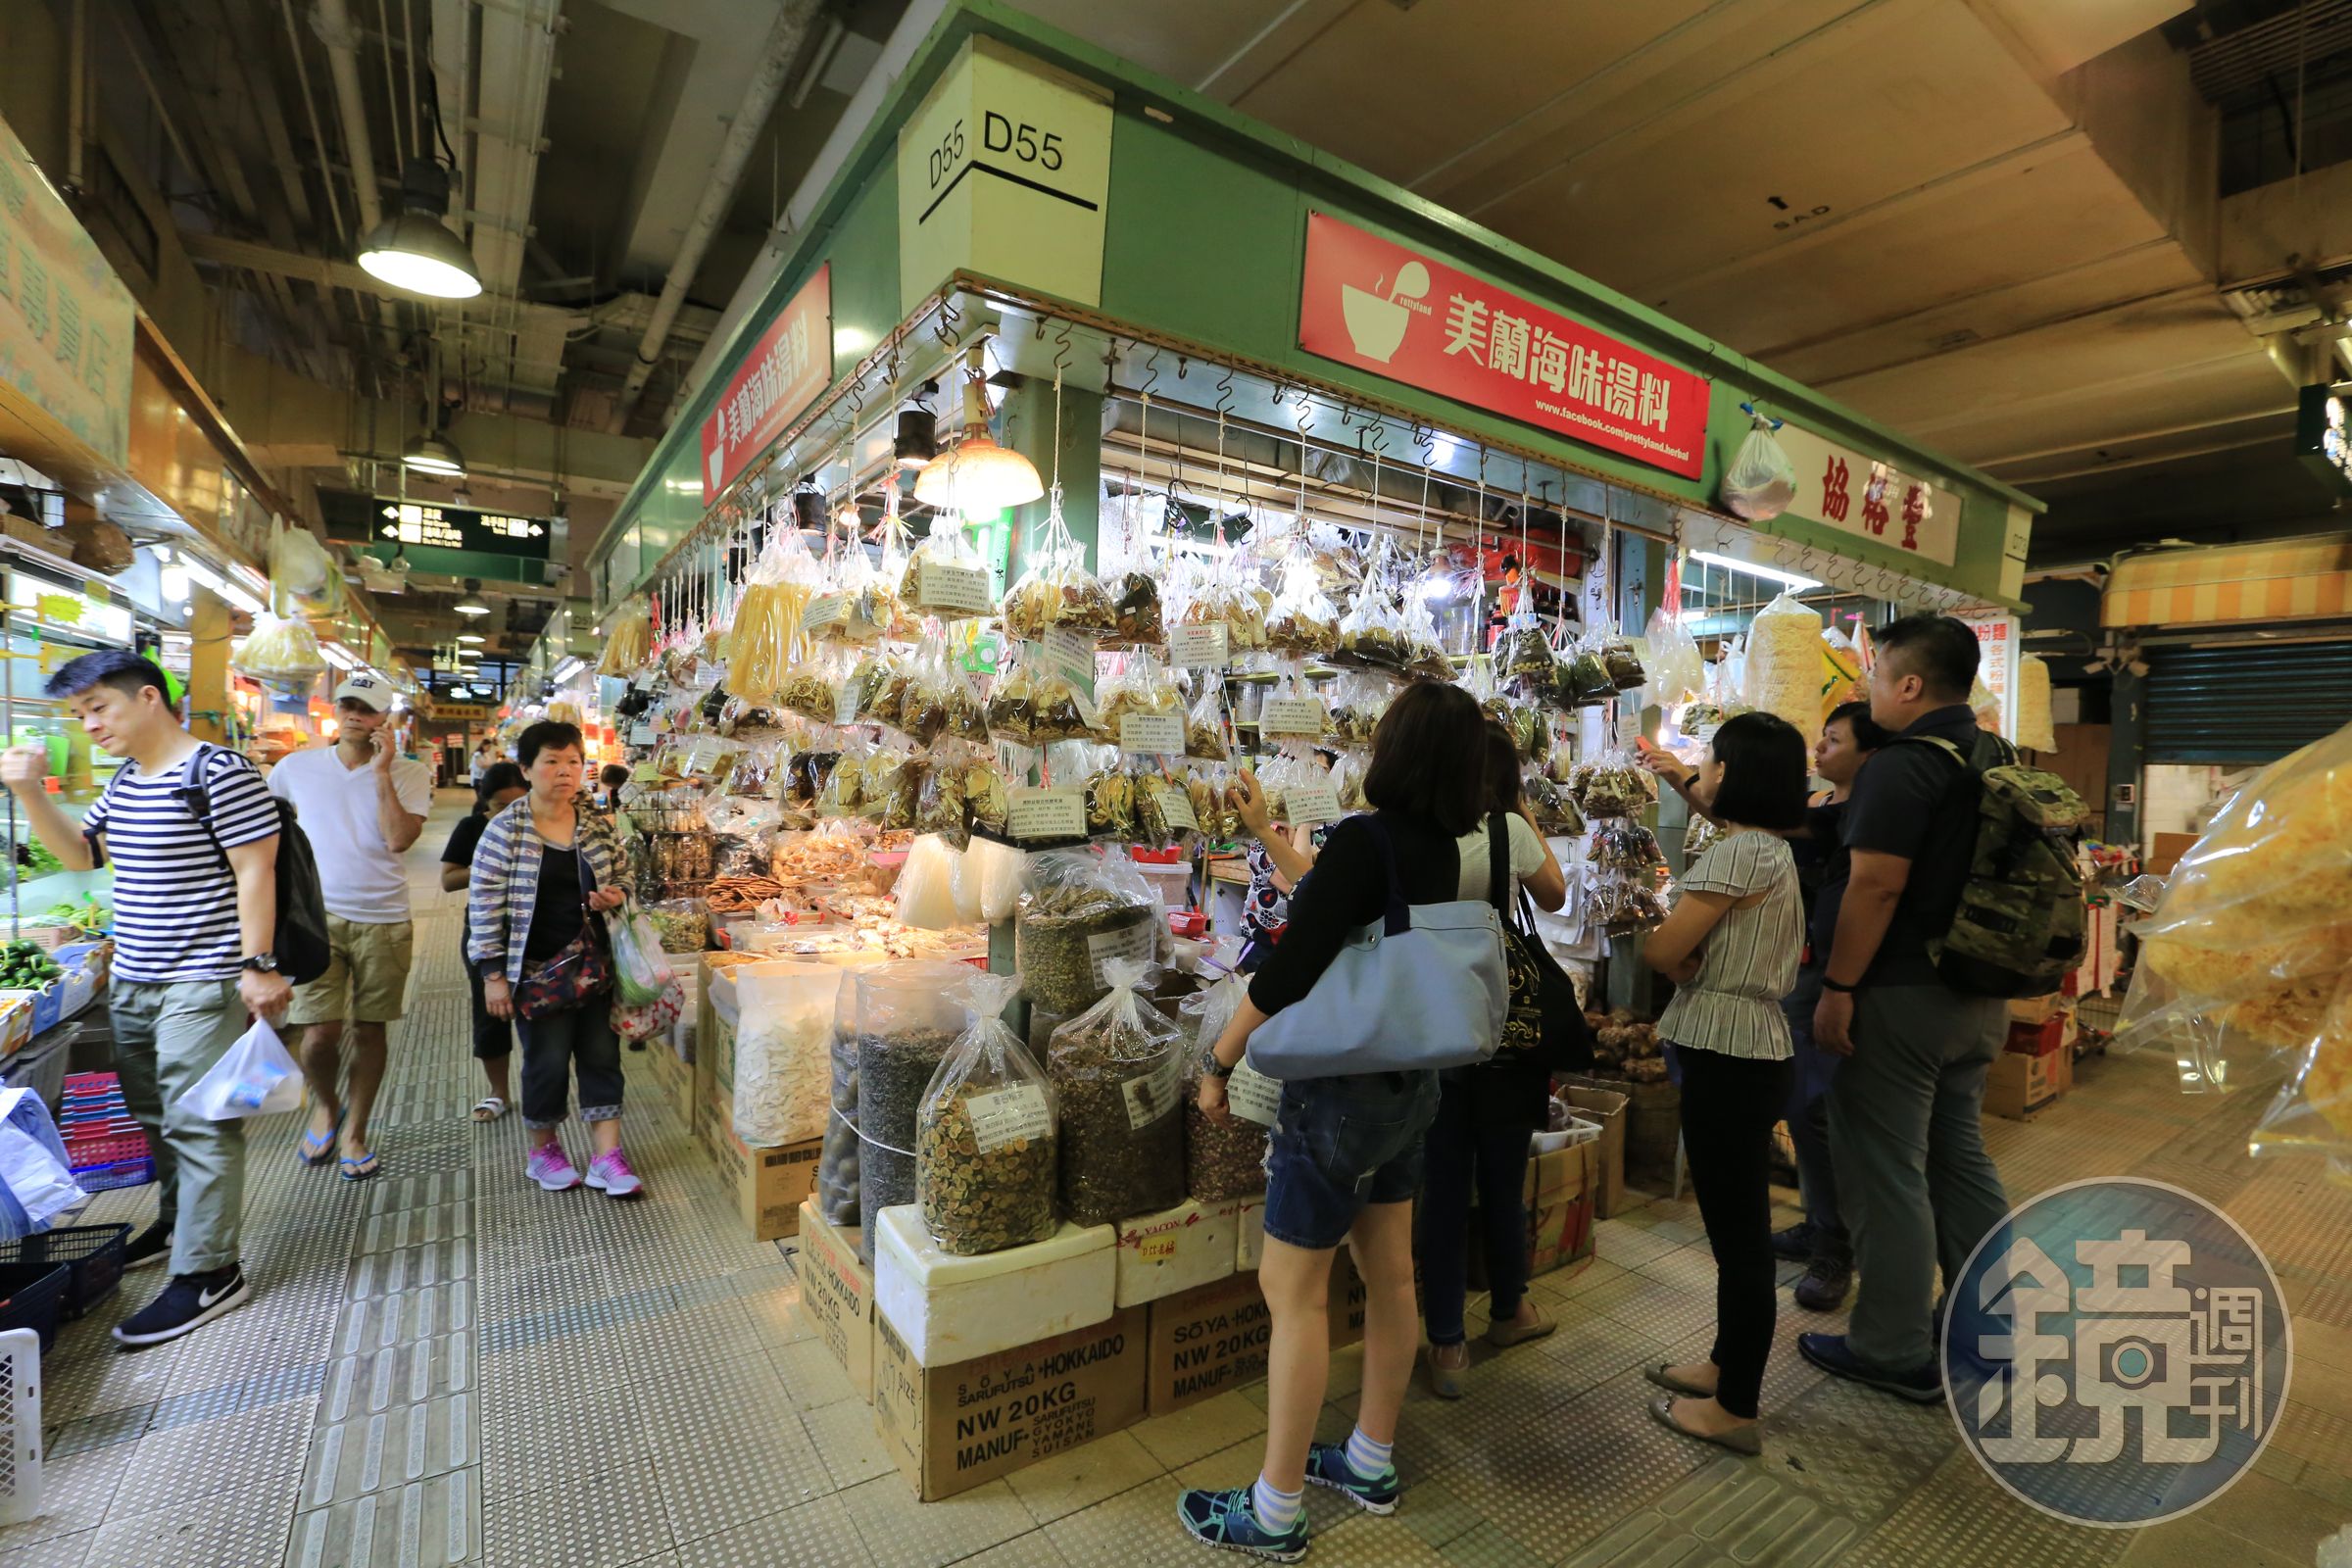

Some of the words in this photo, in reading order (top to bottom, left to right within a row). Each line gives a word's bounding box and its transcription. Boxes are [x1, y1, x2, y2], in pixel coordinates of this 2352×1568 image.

[930, 119, 964, 190] D55
[984, 110, 1063, 171] D55
[727, 308, 808, 454] 美蘭海味湯料
[1443, 292, 1671, 433] 美蘭海味湯料
[1535, 399, 1690, 462] www.facebook.com/prettyland.herbal
[351, 678, 375, 689] CAT
[1173, 1344, 1210, 1372] NW
[1216, 1324, 1269, 1359] 20KG
[899, 1371, 916, 1407] SIZE
[956, 1406, 1002, 1441] NW
[1007, 1381, 1076, 1423] 20KG
[957, 1374, 1036, 1407] SARUFUTSU
